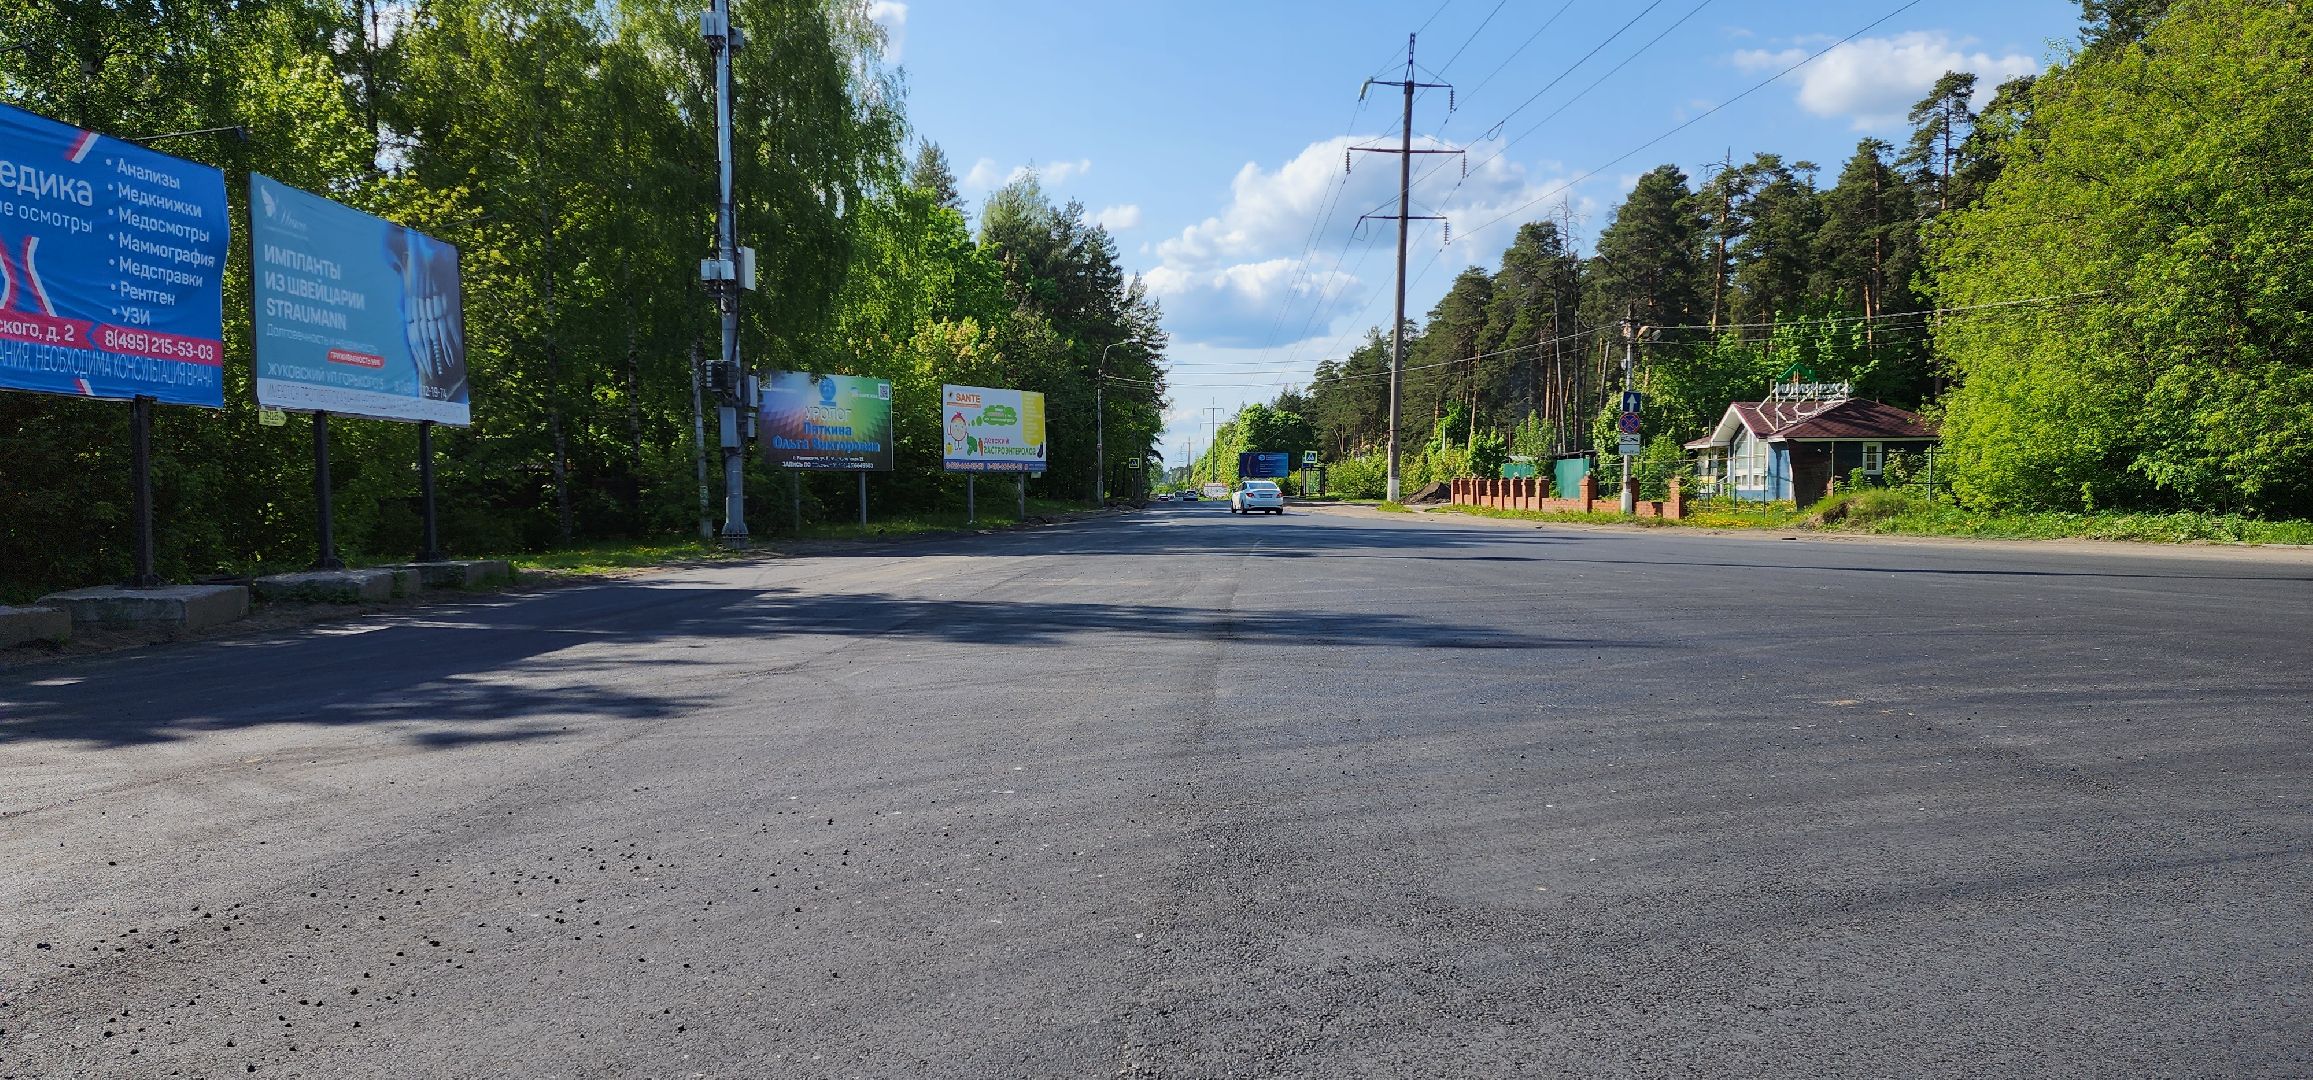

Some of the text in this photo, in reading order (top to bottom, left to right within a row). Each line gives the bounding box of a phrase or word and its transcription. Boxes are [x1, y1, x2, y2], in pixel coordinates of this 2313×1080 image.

[117, 158, 180, 189] Анализы
[118, 182, 202, 217] Медкнижки
[19, 205, 92, 234] осмотры
[119, 206, 209, 243] Медосмотры
[119, 232, 215, 269] Маммография
[264, 244, 341, 280] ИМПЛАНТЫ
[119, 256, 203, 288] Медсправки
[120, 281, 175, 306] Рентген
[265, 271, 365, 310] ИЗ ШВЕЙЦАРИИ
[121, 306, 151, 326] УЗИ
[266, 298, 347, 330] STRAUMANN
[46, 326, 60, 342] д.
[64, 324, 75, 342] 2
[105, 329, 213, 360] 8(495) 215-53-03
[35, 342, 111, 378] НЕОБХОДИМА
[114, 353, 186, 388] КОНСУЛЬТАЦИЯ
[956, 393, 981, 403] SANTE
